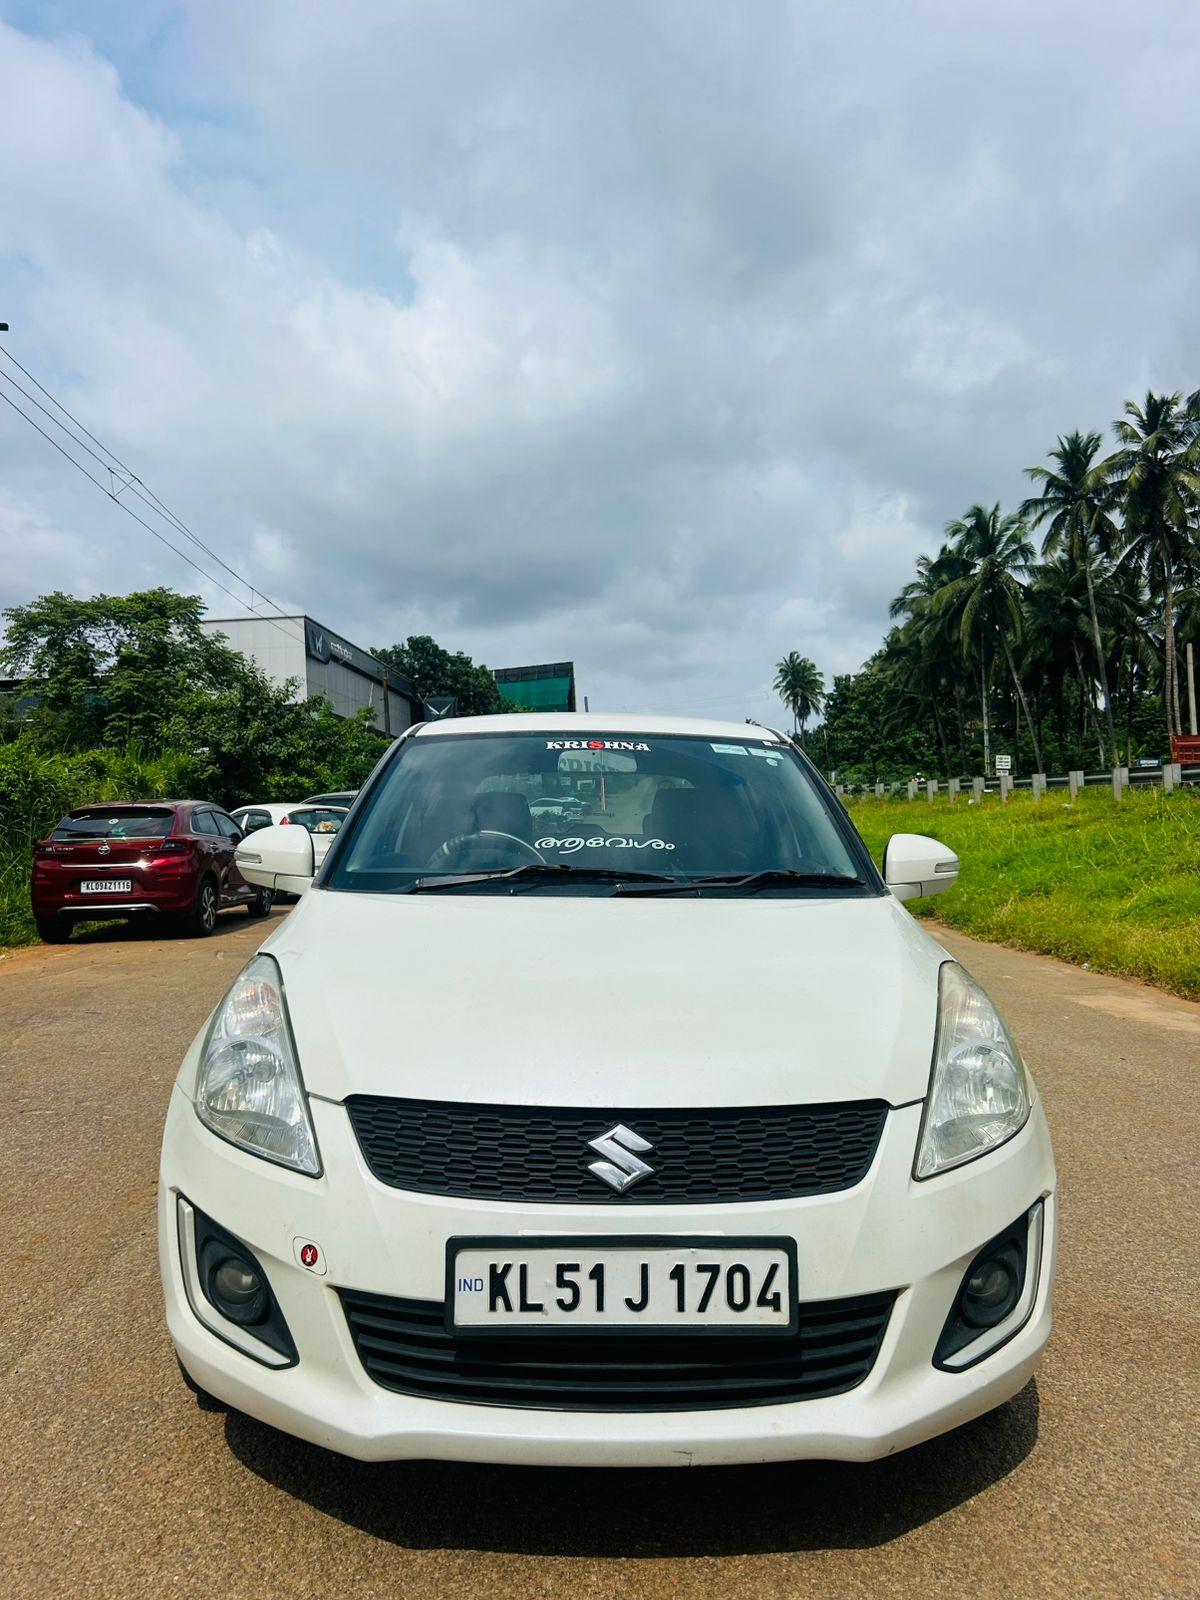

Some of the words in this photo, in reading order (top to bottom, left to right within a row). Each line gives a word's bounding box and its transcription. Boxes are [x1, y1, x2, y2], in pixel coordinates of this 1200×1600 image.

[546, 740, 651, 751] KRISHNA
[458, 1278, 484, 1292] IND
[489, 1263, 544, 1312] KL
[556, 1263, 605, 1312] 51
[624, 1263, 648, 1312] J
[669, 1263, 781, 1312] 1704
